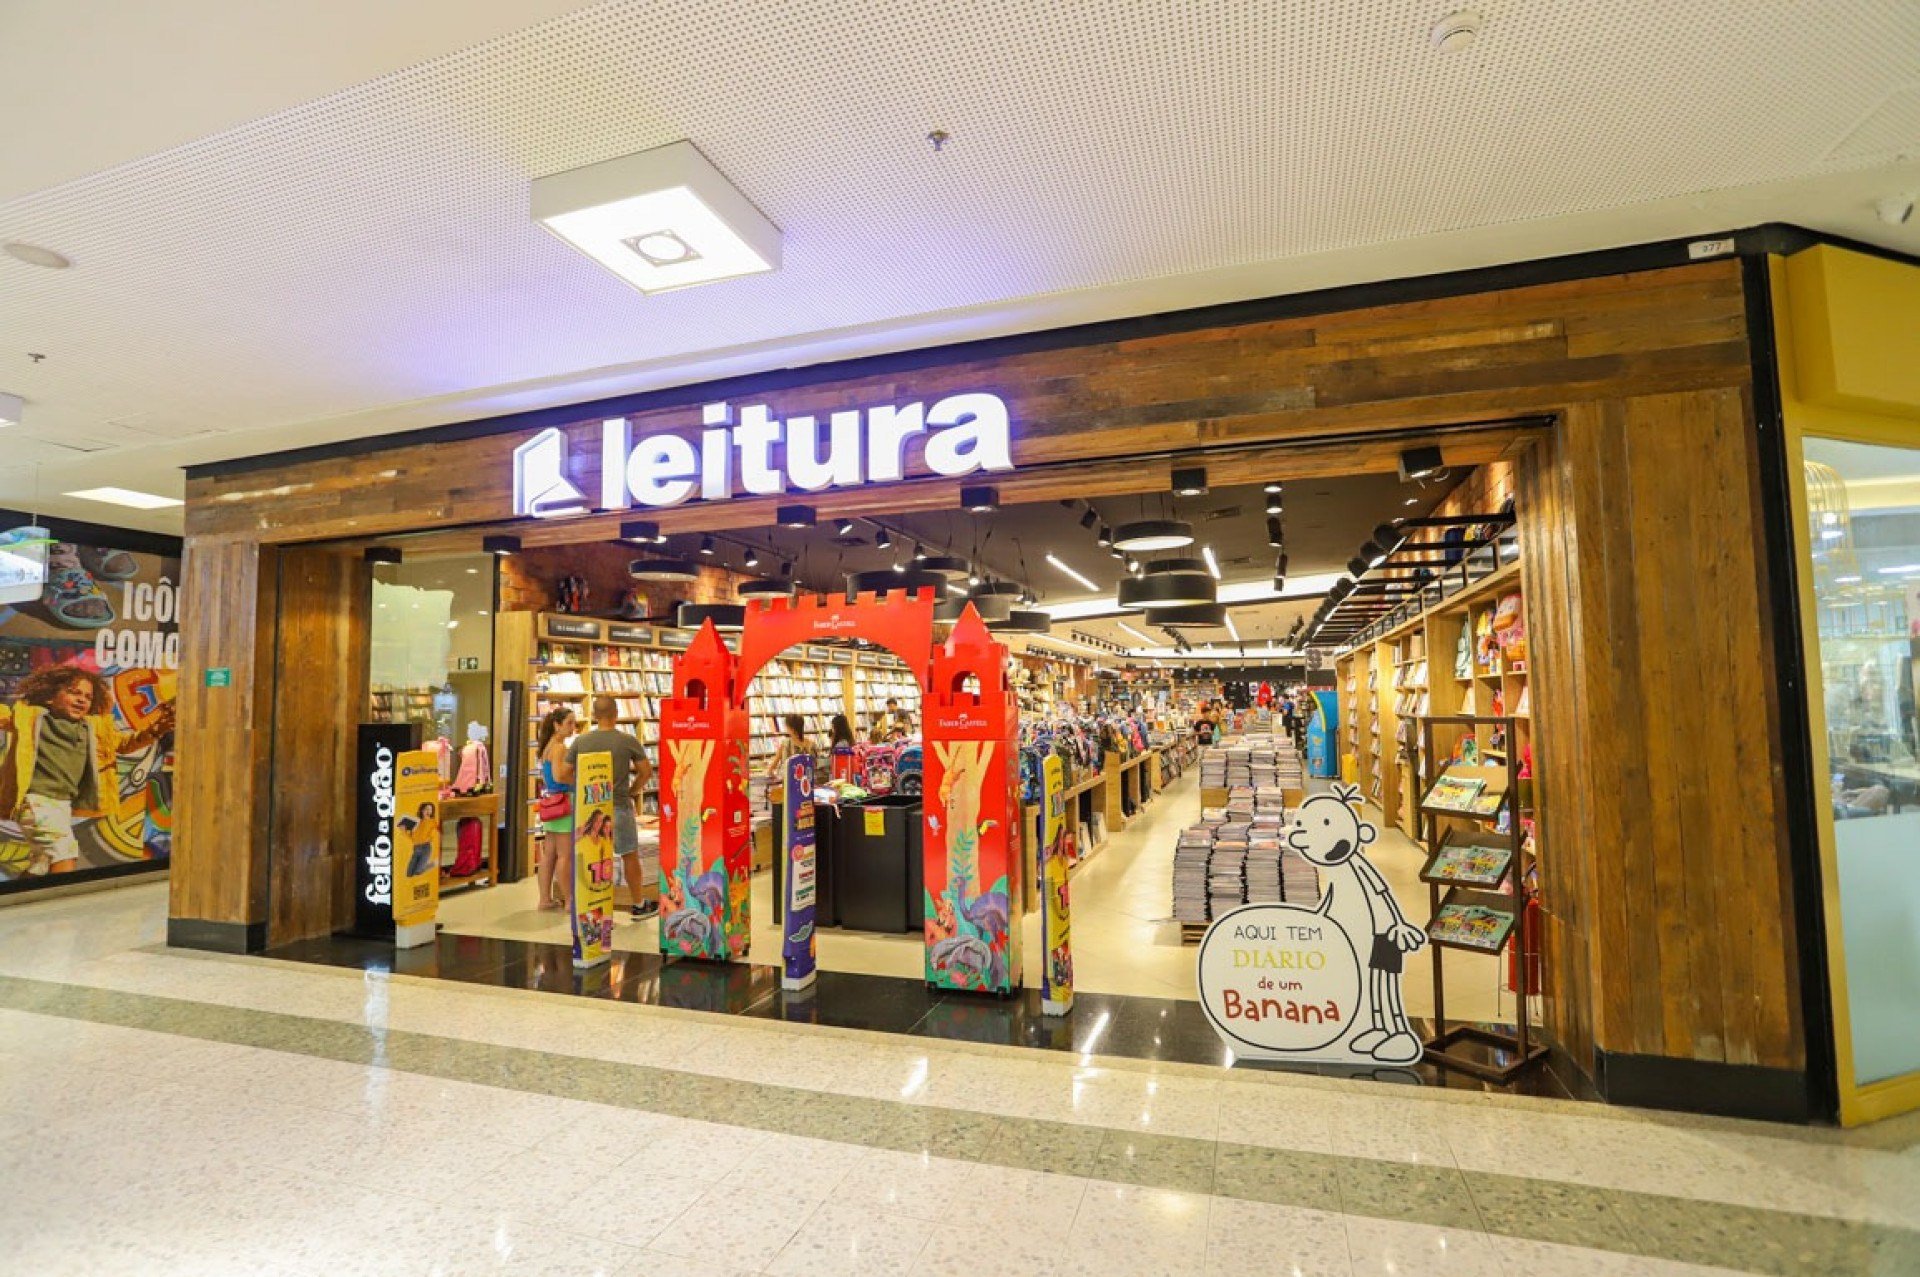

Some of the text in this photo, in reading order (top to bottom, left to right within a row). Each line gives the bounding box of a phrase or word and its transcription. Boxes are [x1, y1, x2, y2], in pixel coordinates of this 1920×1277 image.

[601, 393, 1014, 510] leitura
[365, 834, 392, 905] feito
[1233, 925, 1323, 941] AQUI TEM
[1232, 946, 1326, 970] DIÁRIO
[1257, 976, 1303, 991] de um
[1222, 989, 1340, 1024] Banana
